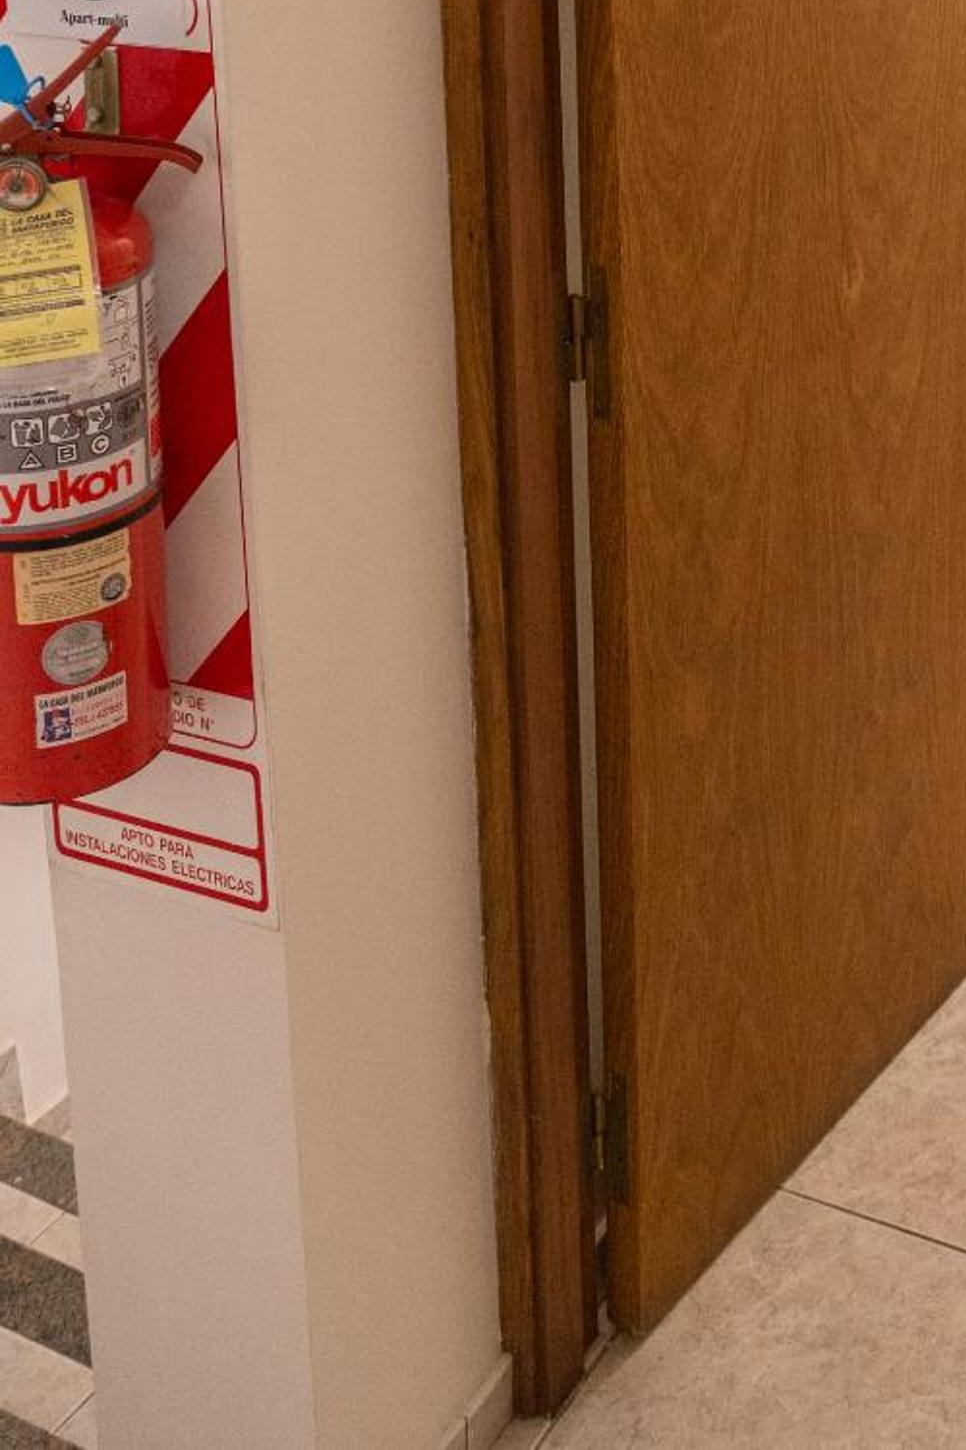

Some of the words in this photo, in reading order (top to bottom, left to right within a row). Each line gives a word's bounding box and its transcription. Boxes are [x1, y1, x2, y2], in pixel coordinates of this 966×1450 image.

[0, 458, 133, 524] yukon
[186, 694, 206, 711] DE
[65, 829, 166, 871] INSTALACIONES
[171, 859, 254, 896] ELECTRICAS
[121, 827, 156, 848] APTO
[159, 838, 195, 859] PARA
